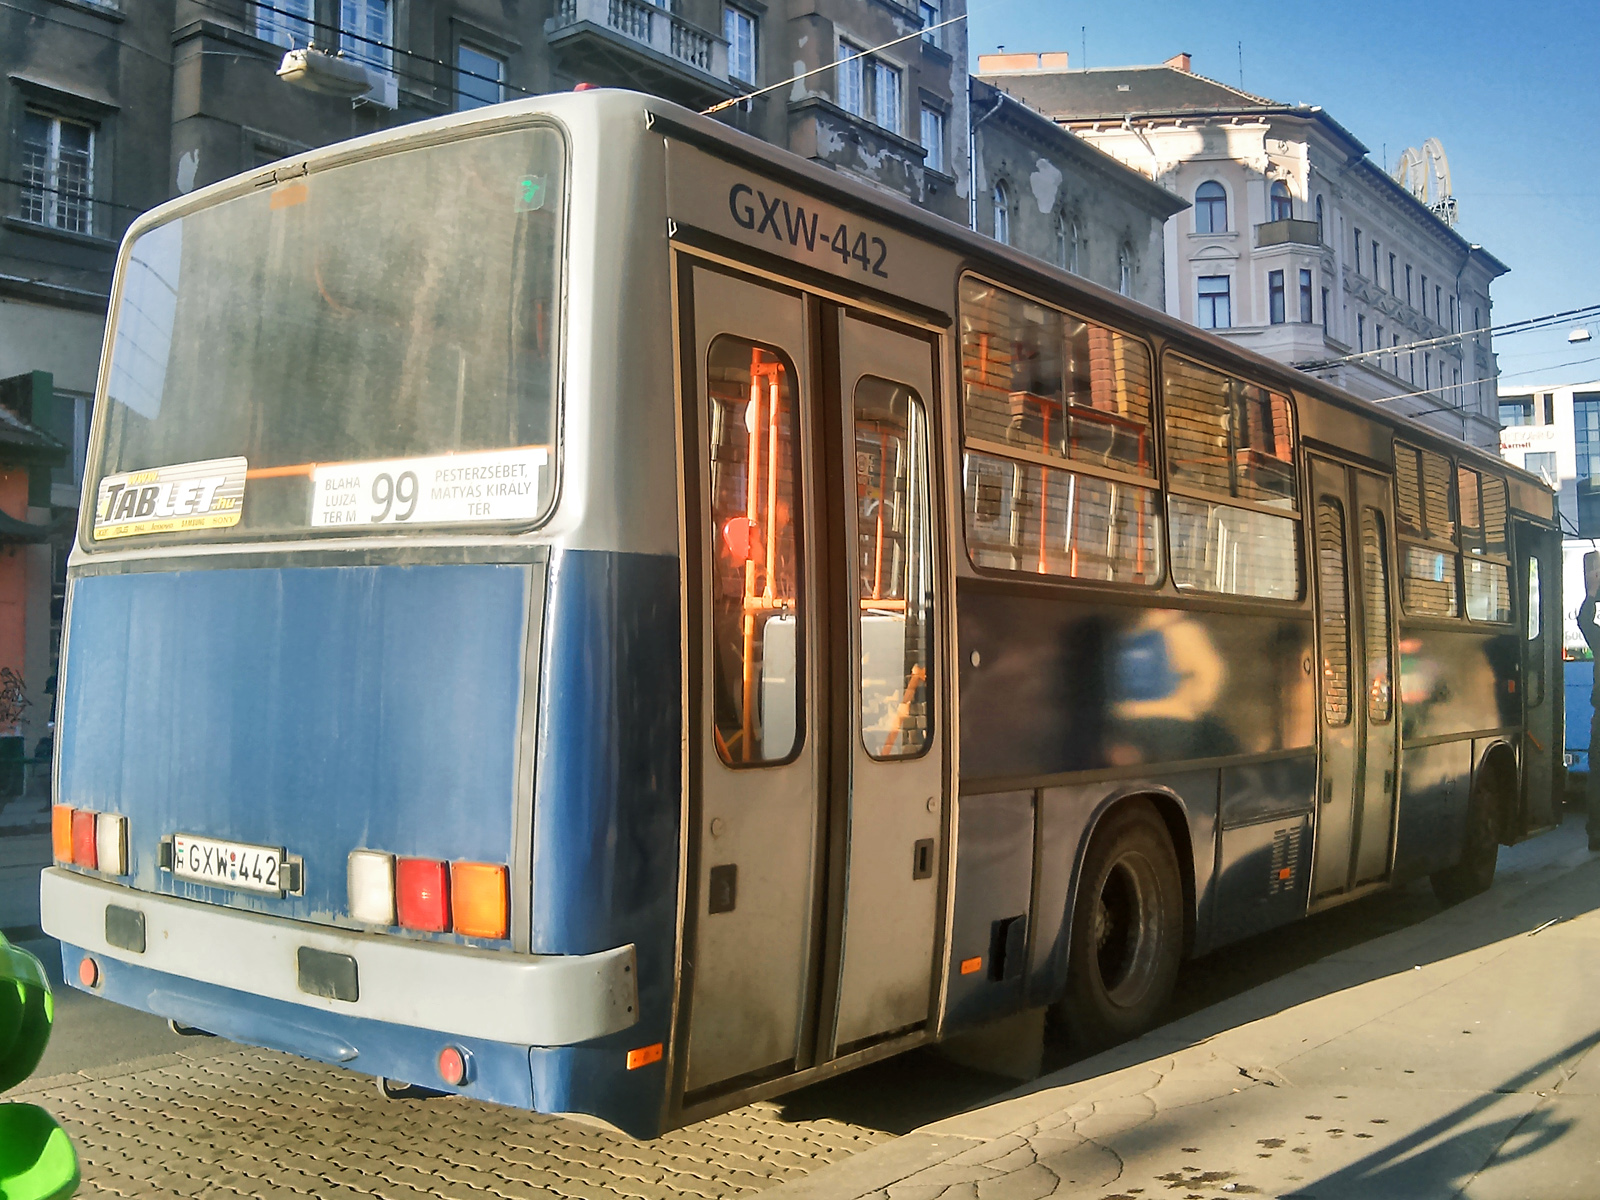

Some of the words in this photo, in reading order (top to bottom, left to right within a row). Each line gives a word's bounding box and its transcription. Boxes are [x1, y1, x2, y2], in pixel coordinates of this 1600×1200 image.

[729, 183, 888, 279] GXW-442
[325, 476, 361, 491] BLAHA
[325, 493, 357, 507] LUJZA
[370, 470, 419, 523] 99
[213, 516, 235, 525] SONY
[345, 510, 357, 523] M
